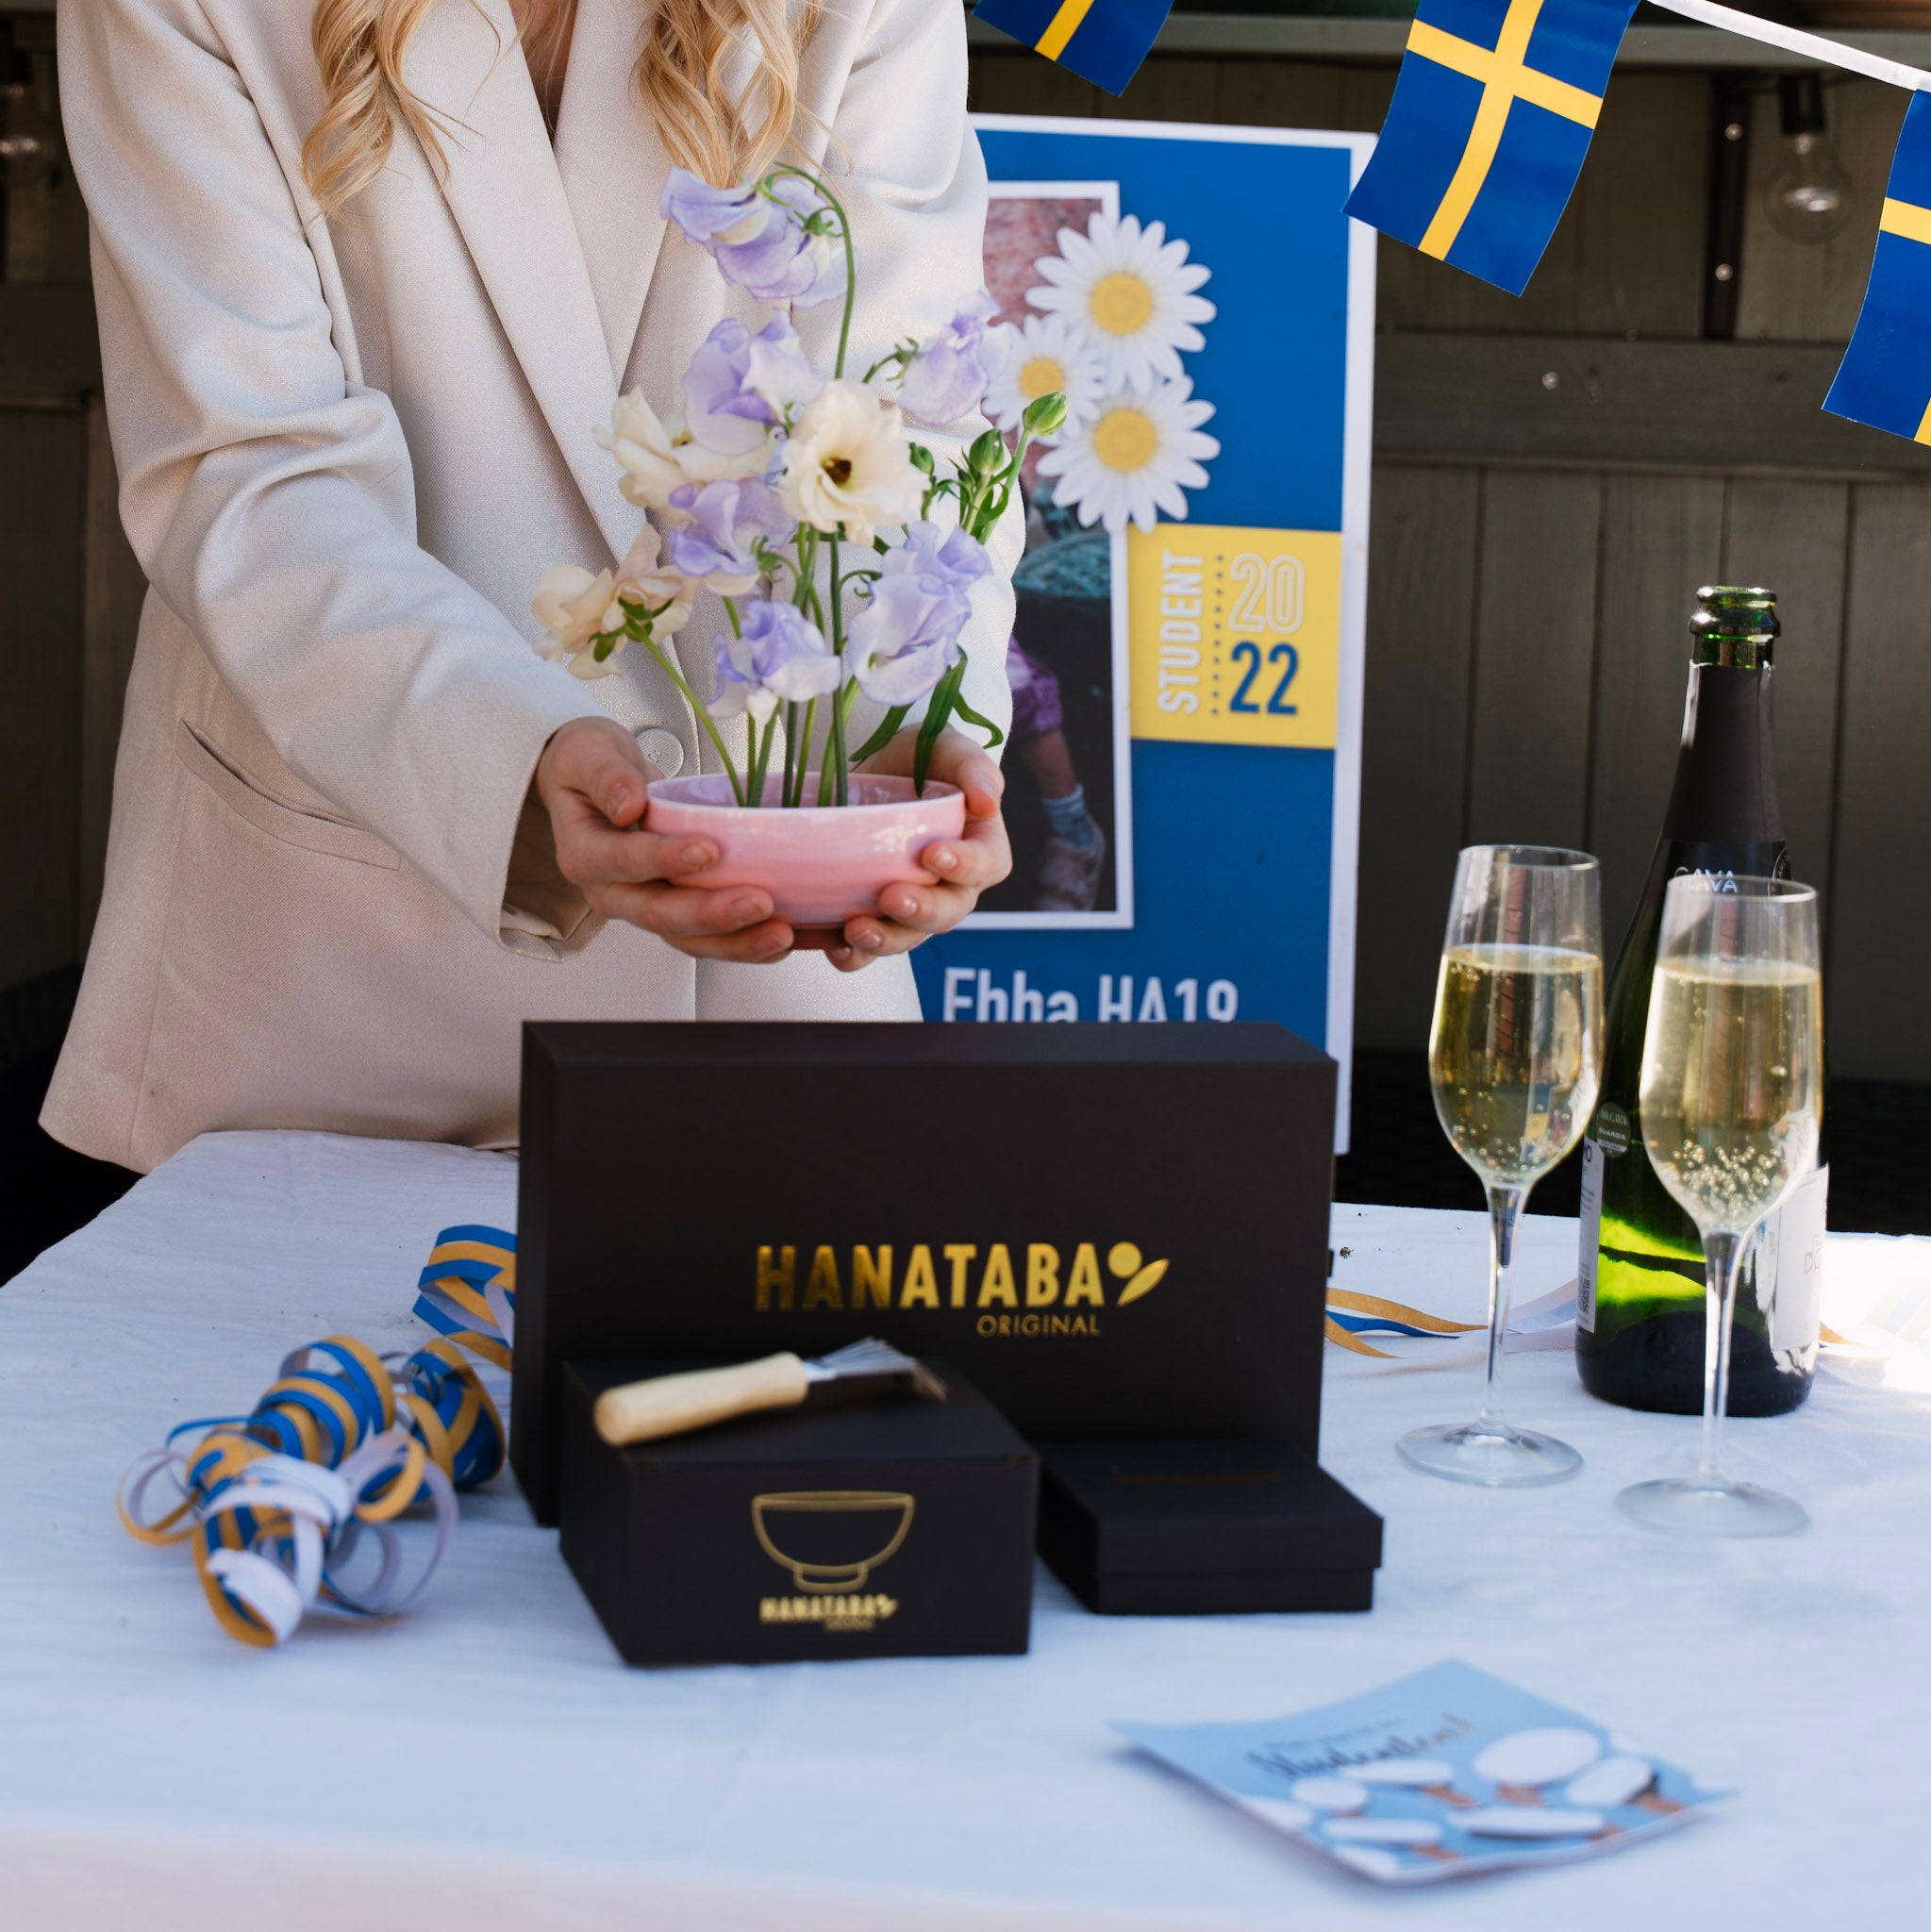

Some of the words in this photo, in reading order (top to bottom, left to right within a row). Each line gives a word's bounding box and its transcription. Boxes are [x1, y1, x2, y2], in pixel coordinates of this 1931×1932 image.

[1157, 548, 1204, 715] STUDENT
[1228, 552, 1305, 635] 20
[1229, 640, 1299, 716] 22
[756, 1242, 1106, 1310] HANATABA
[975, 1314, 1101, 1337] ORIGINAL
